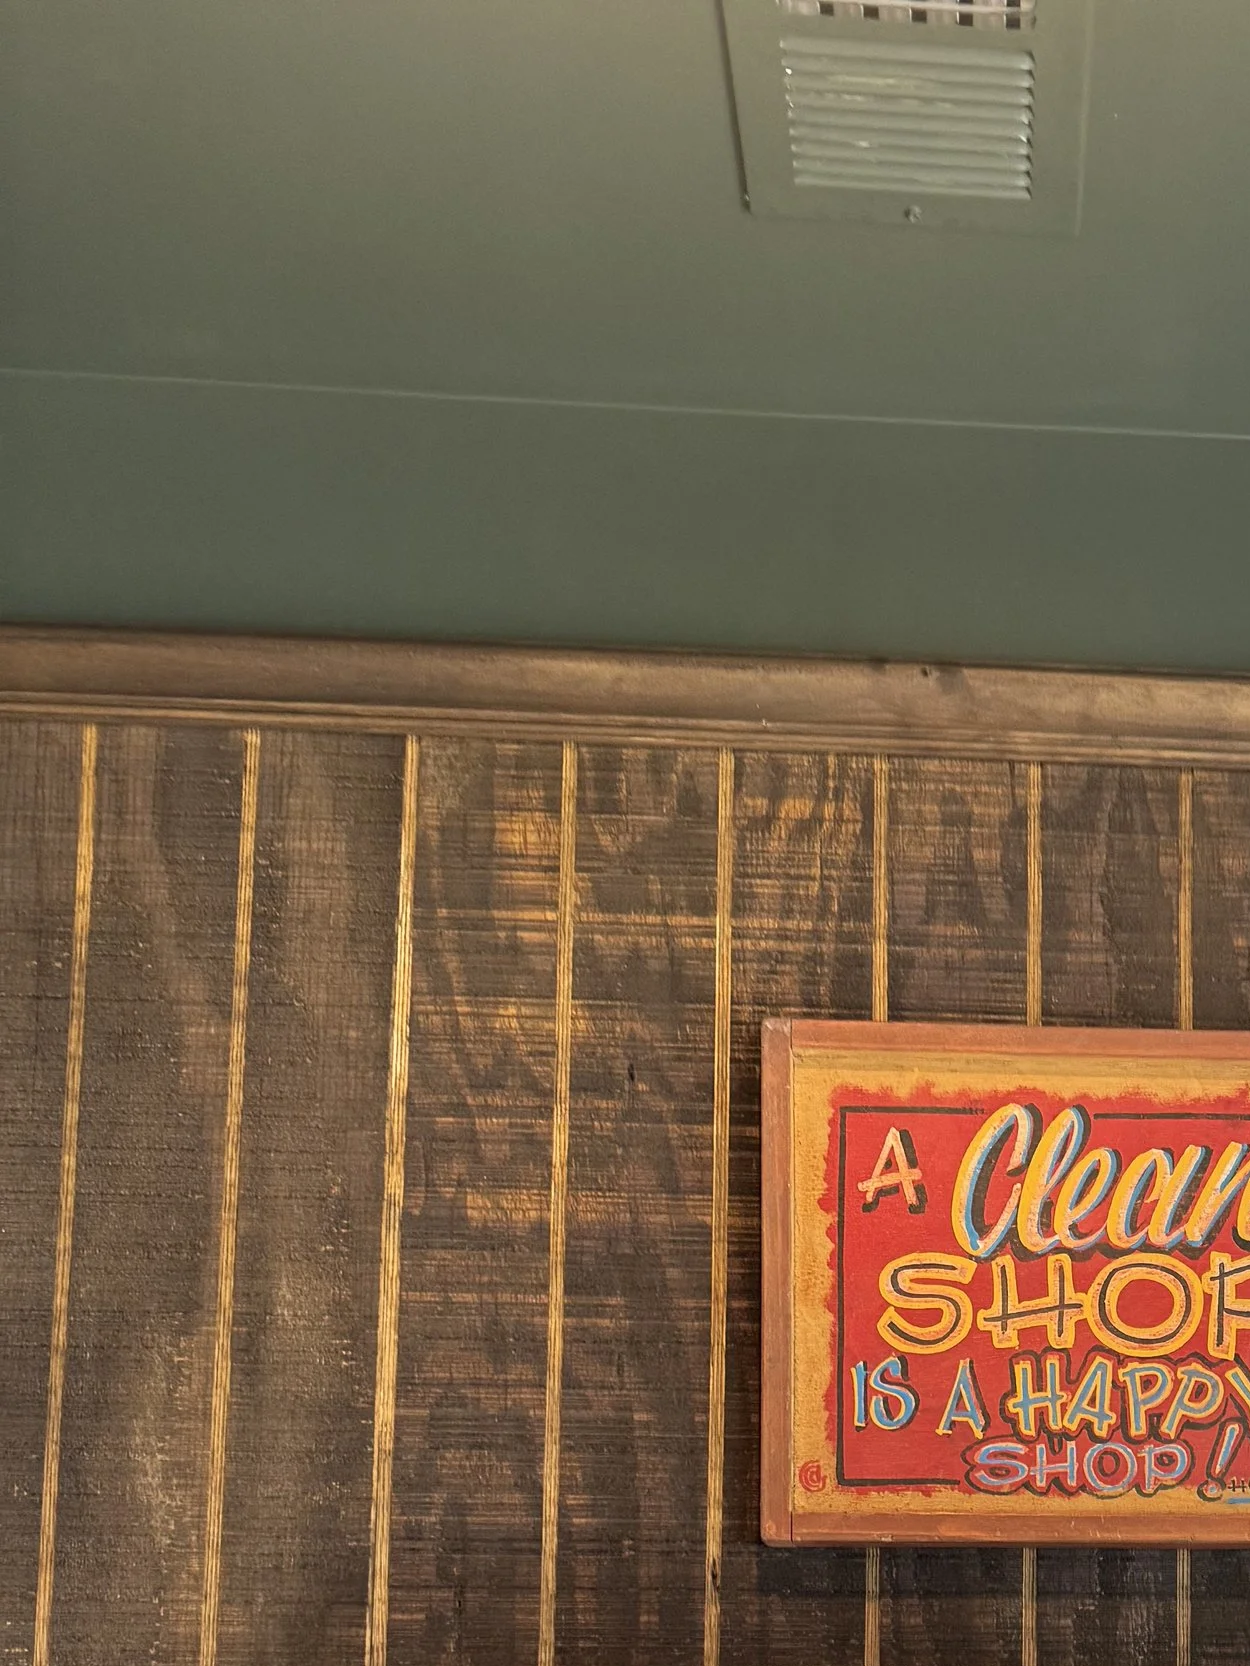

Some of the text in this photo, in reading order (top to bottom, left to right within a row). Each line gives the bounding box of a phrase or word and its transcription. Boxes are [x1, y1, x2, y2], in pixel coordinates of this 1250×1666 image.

[857, 1127, 923, 1210] A
[851, 1355, 914, 1430] IS
[937, 1358, 988, 1438] A
